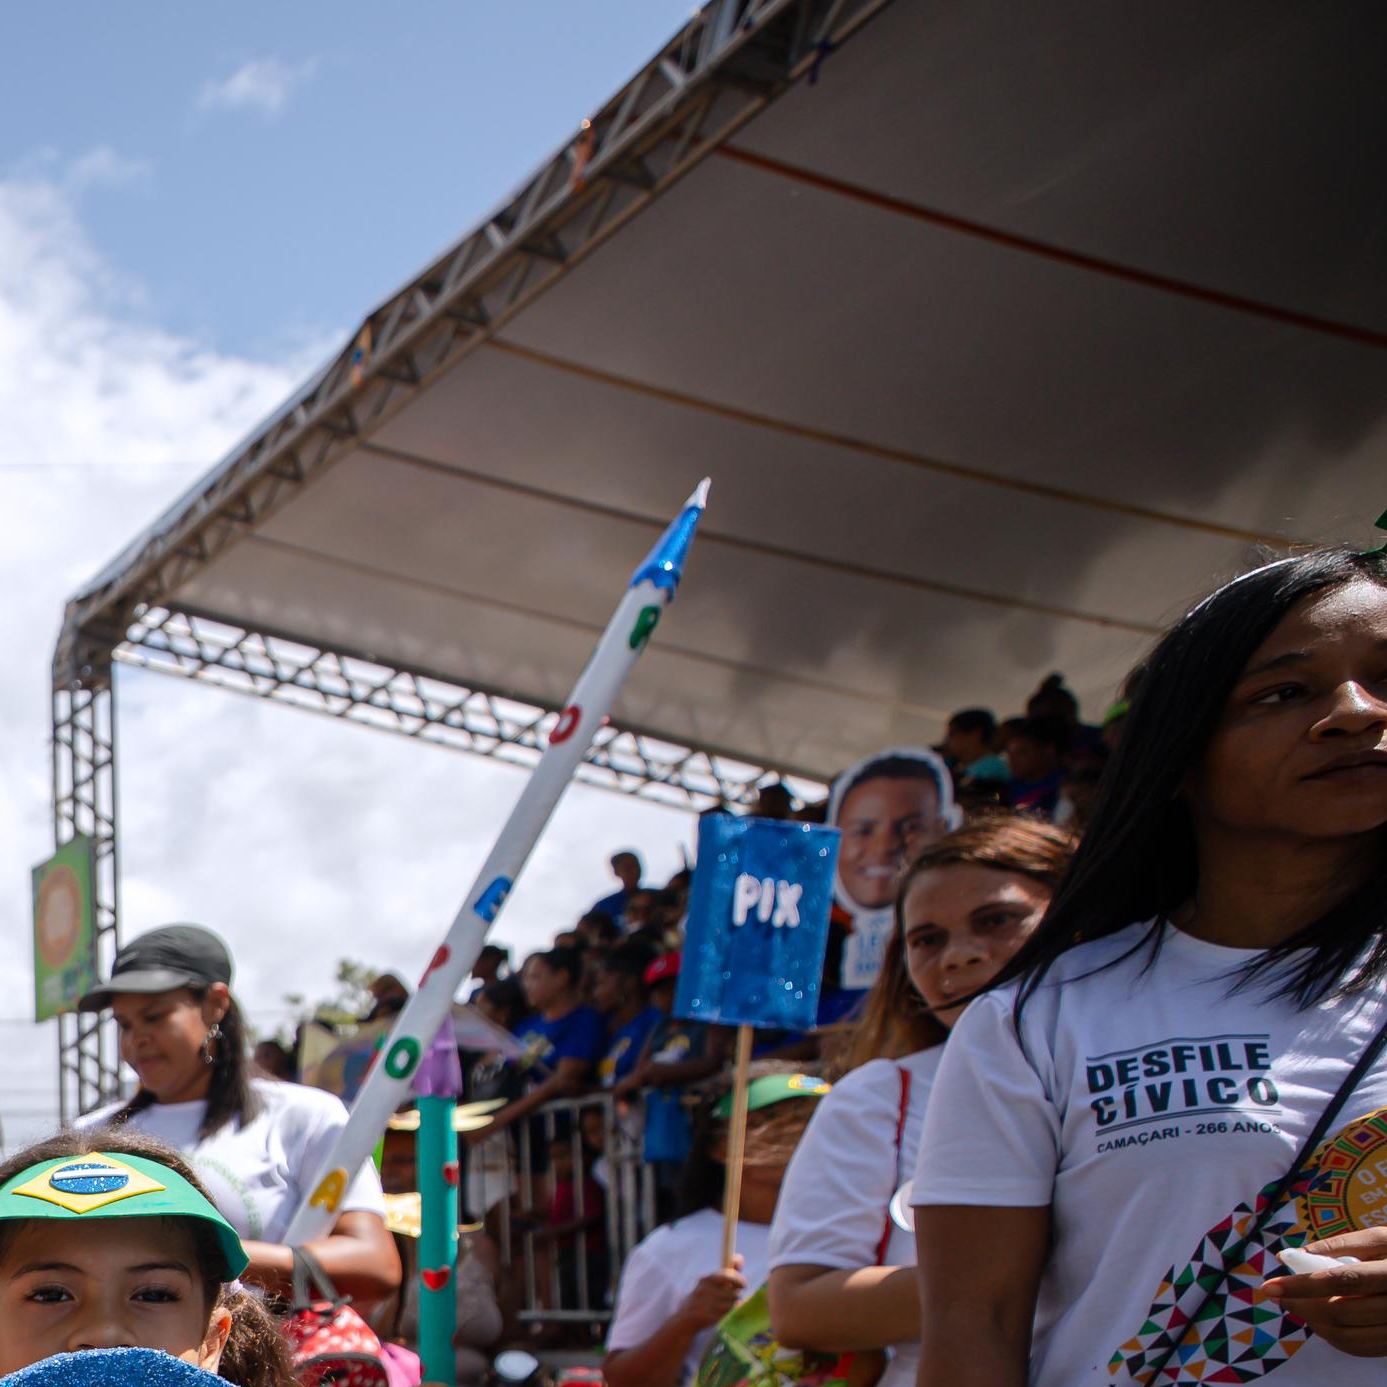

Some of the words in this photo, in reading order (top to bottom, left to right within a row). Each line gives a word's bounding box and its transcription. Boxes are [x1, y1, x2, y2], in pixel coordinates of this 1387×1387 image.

[732, 872, 803, 928] PIX
[1086, 1043, 1271, 1094] DESFILE
[1091, 1077, 1278, 1127] CÍVICO
[1097, 1127, 1180, 1153] CAMAÇARI
[1196, 1123, 1228, 1135] 266
[1233, 1121, 1282, 1135] ANOS
